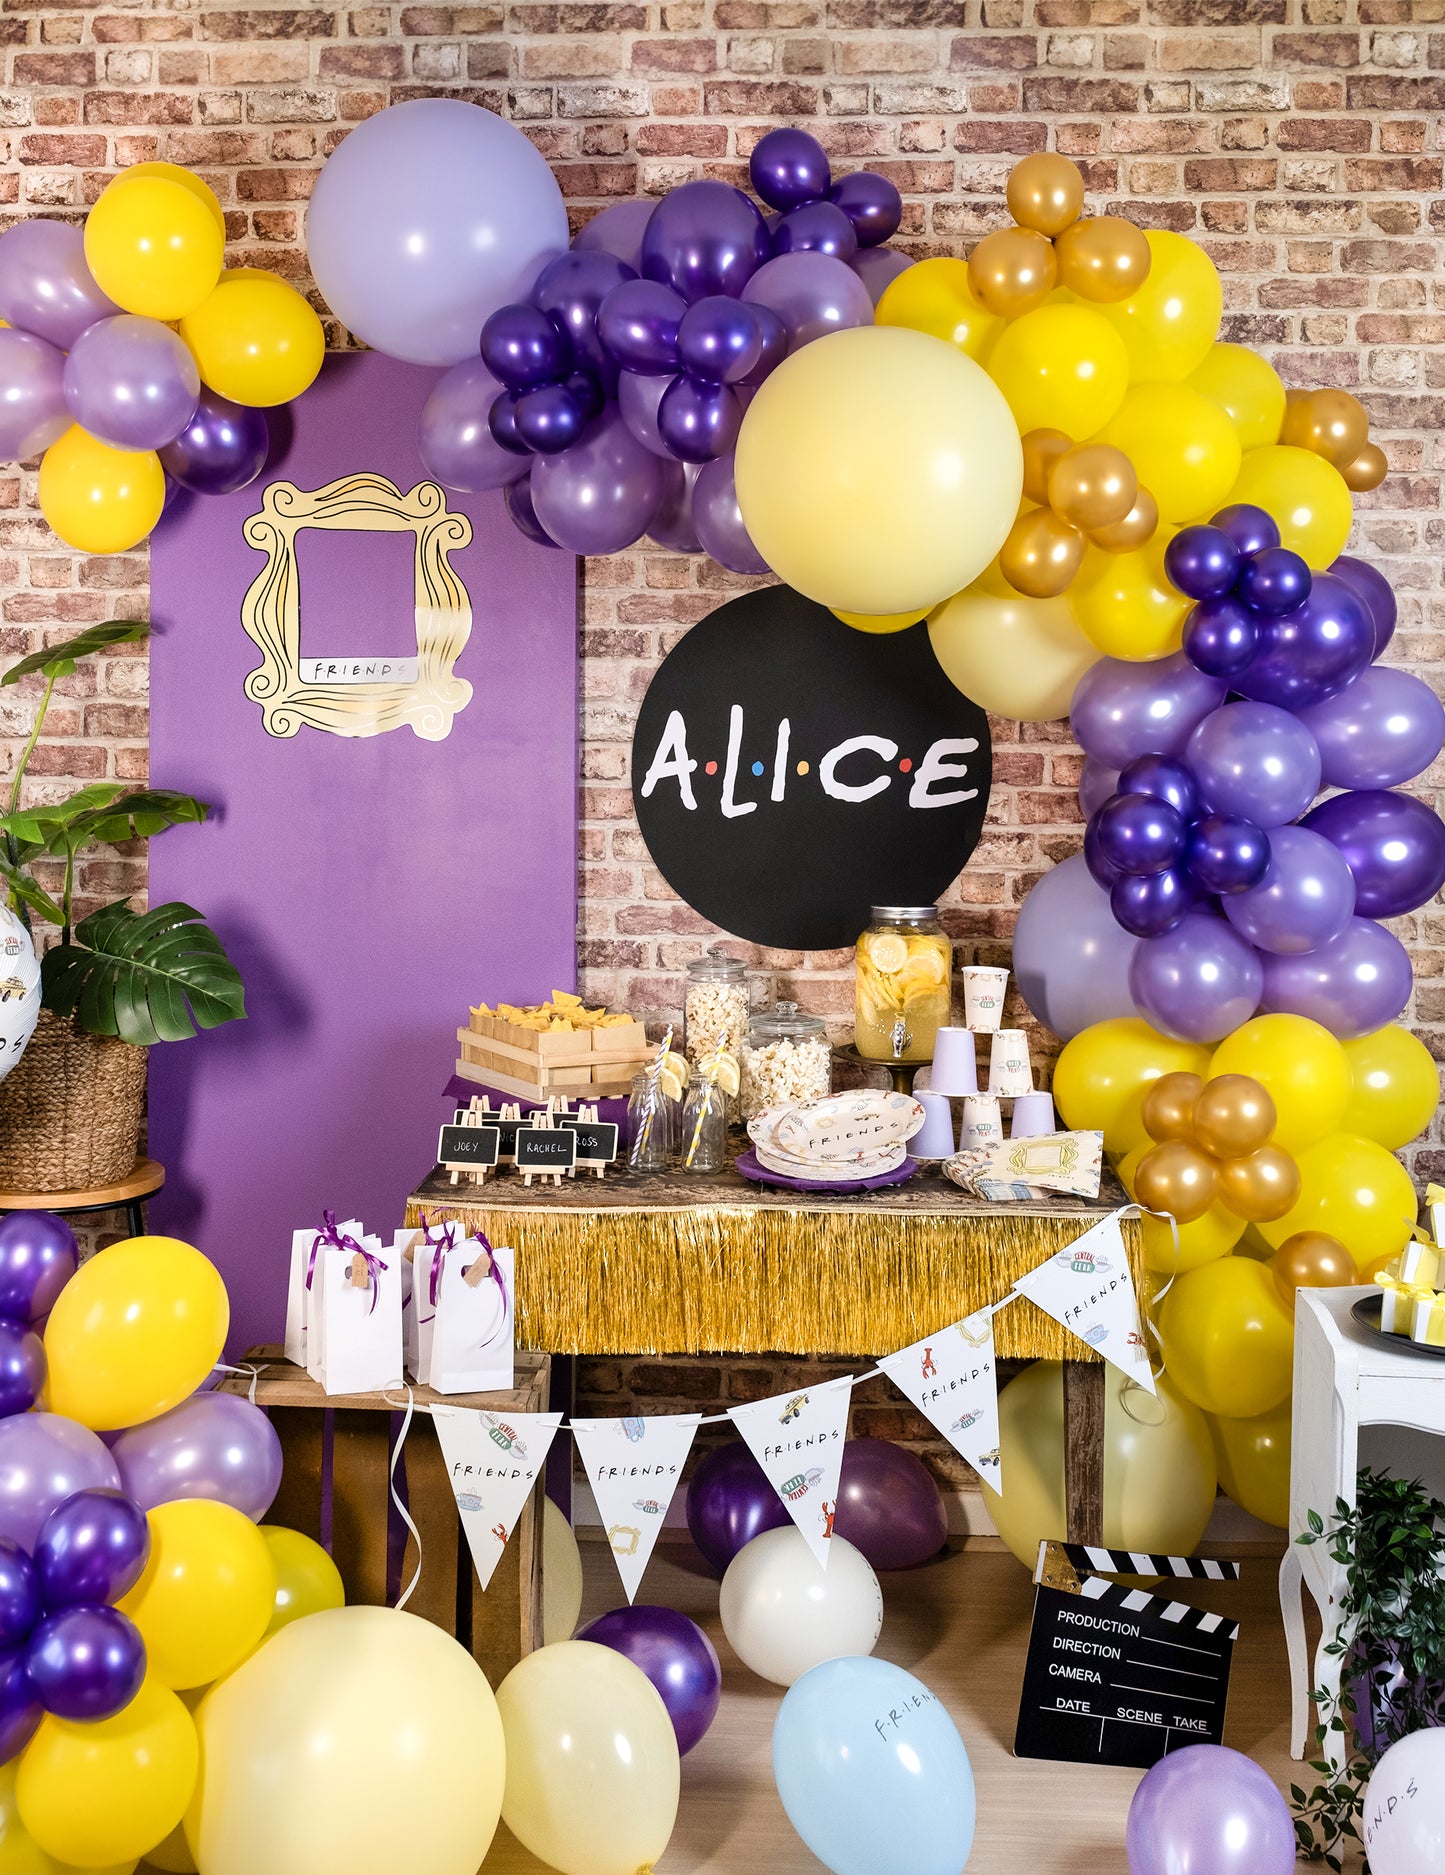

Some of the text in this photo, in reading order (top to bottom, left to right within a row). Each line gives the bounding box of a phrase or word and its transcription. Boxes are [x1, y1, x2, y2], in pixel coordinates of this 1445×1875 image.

[453, 1142, 479, 1152] JOEY
[526, 1142, 567, 1153] RACHEL
[576, 1136, 598, 1147] ROSS
[1057, 1610, 1140, 1637] PRODUCTION
[1053, 1637, 1121, 1660] DIRECTION
[1049, 1663, 1102, 1684] CAMERA
[1056, 1697, 1207, 1731] DATE SCENE TAKE
